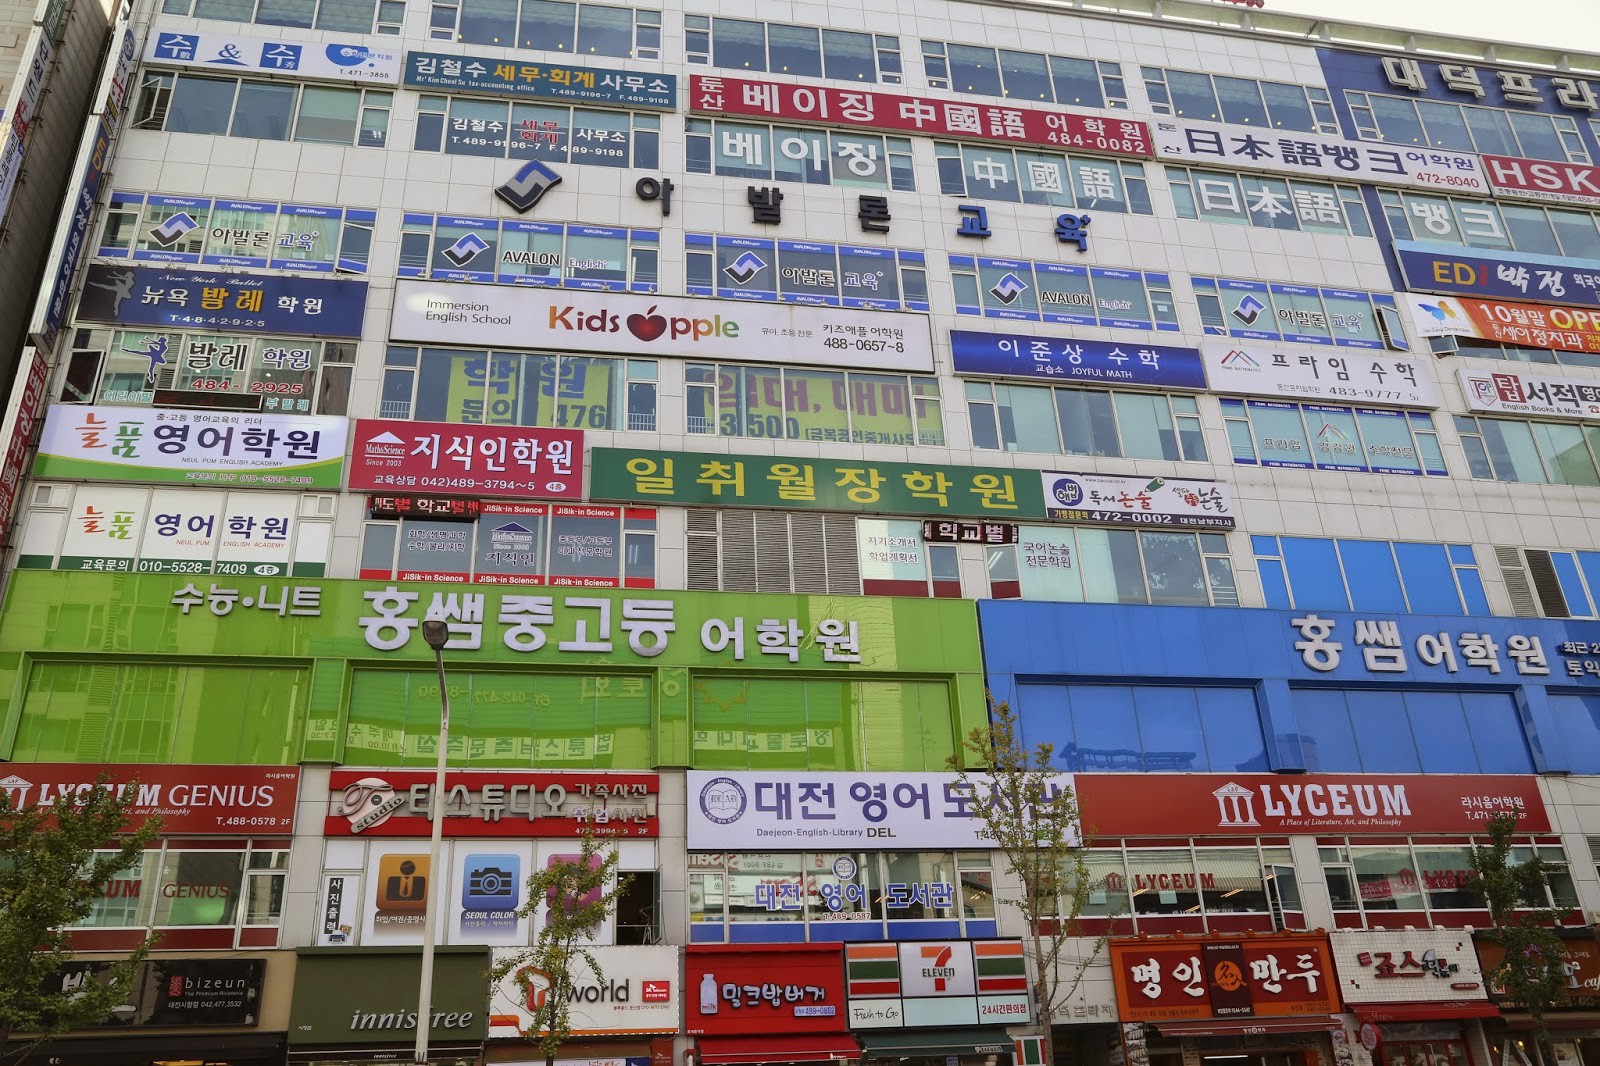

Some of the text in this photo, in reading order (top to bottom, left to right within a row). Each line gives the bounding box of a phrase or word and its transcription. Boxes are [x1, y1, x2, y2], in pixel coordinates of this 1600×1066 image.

[416, 57, 670, 92] 김철수 세무·회계 사무소
[742, 84, 875, 122] 베이징
[899, 99, 1025, 139] 中國語
[1045, 114, 1143, 139] 어학원
[453, 118, 626, 143] 김철수 세무 회계 사무소
[1047, 131, 1146, 154] 484-0082
[722, 131, 877, 177] 베이징
[1406, 152, 1475, 170] 어학원
[973, 156, 1115, 201] 中國語
[1416, 171, 1480, 189] 472-8040
[1491, 161, 1600, 193] HSK
[1197, 179, 1341, 225] 日本語
[1411, 201, 1504, 238] 뱅크
[211, 227, 313, 252] 아발론 교육
[502, 251, 606, 270] AVALON English
[159, 274, 218, 284] New York
[782, 267, 879, 290] 아발론 교육
[1496, 263, 1566, 297] 박정
[142, 285, 323, 315] 뉴욕 발레 학원
[427, 299, 489, 312] Immersion
[1041, 291, 1131, 310] AVALON English
[426, 311, 512, 325] English School
[549, 305, 620, 334] Kids
[1278, 308, 1362, 330] 아발론 교육
[1479, 303, 1546, 326] 10월말
[797, 329, 813, 338] 전문
[823, 323, 904, 339] 키즈애플 어학원
[823, 338, 905, 353] 488-0657~8
[998, 340, 1160, 370] 이준상 수학
[187, 341, 311, 371] 발레 학원
[1035, 364, 1133, 379] 교습소 JOYFUL MATH
[1271, 353, 1418, 387] 프라임 수학
[1329, 387, 1401, 400] 483-9777
[1527, 382, 1580, 408] 서적
[1532, 405, 1554, 413] Books
[193, 415, 263, 424] 영어교육의 리더
[75, 412, 321, 460] 늘품 영어학원
[410, 433, 573, 475] 지식인학원
[240, 475, 314, 484] 010-5528-7409
[374, 475, 535, 490] 교육상담 042)489-3794~5
[626, 456, 1018, 510] 일취월장학원
[484, 504, 511, 514] JiSik-in
[513, 506, 543, 514] Science
[556, 507, 615, 517] JiSik-in Science
[1092, 511, 1232, 526] 472-0002 대전남부지사
[154, 514, 215, 538] 영어
[228, 515, 289, 540] 학원
[868, 537, 916, 547] 자기소개서
[1024, 542, 1071, 555] 국어논술
[486, 551, 535, 566] 지식인
[869, 551, 918, 563] 학업계획서
[1025, 555, 1072, 569] 전문학원
[80, 559, 247, 575] 교육문의 010-5528-7409
[358, 586, 862, 663] 홍쌤중고등 어학원
[1291, 614, 1551, 675] 홍쌤 어학원
[1561, 641, 1588, 654] 최근
[168, 785, 274, 807] GENIUS
[754, 782, 837, 820] 대전
[849, 782, 931, 823] 영어
[1259, 784, 1412, 817] LYCEUM
[1461, 796, 1525, 809] 라시움어학원
[151, 808, 191, 817] Philosophy
[356, 797, 402, 830] studio
[574, 784, 648, 800] 가족사진
[1371, 818, 1402, 827] Philosophy
[866, 827, 897, 838] DEL
[162, 883, 230, 899] GENIUS
[1135, 873, 1215, 890] LYCEUM
[326, 879, 342, 931] 사진출력
[754, 884, 802, 911] 대전
[819, 884, 869, 911] 영어
[887, 883, 954, 910] 도서관
[465, 911, 514, 920] SEOUL COLOR
[185, 978, 245, 989] bizeun
[1131, 954, 1321, 999] 명인 만두
[566, 979, 630, 1003] world
[722, 983, 825, 1008] 밀크밥버거
[702, 1003, 717, 1011] milk
[886, 1007, 899, 1020] Go
[982, 1004, 1027, 1015] 24시간편의점
[351, 1008, 473, 1030] innisree
